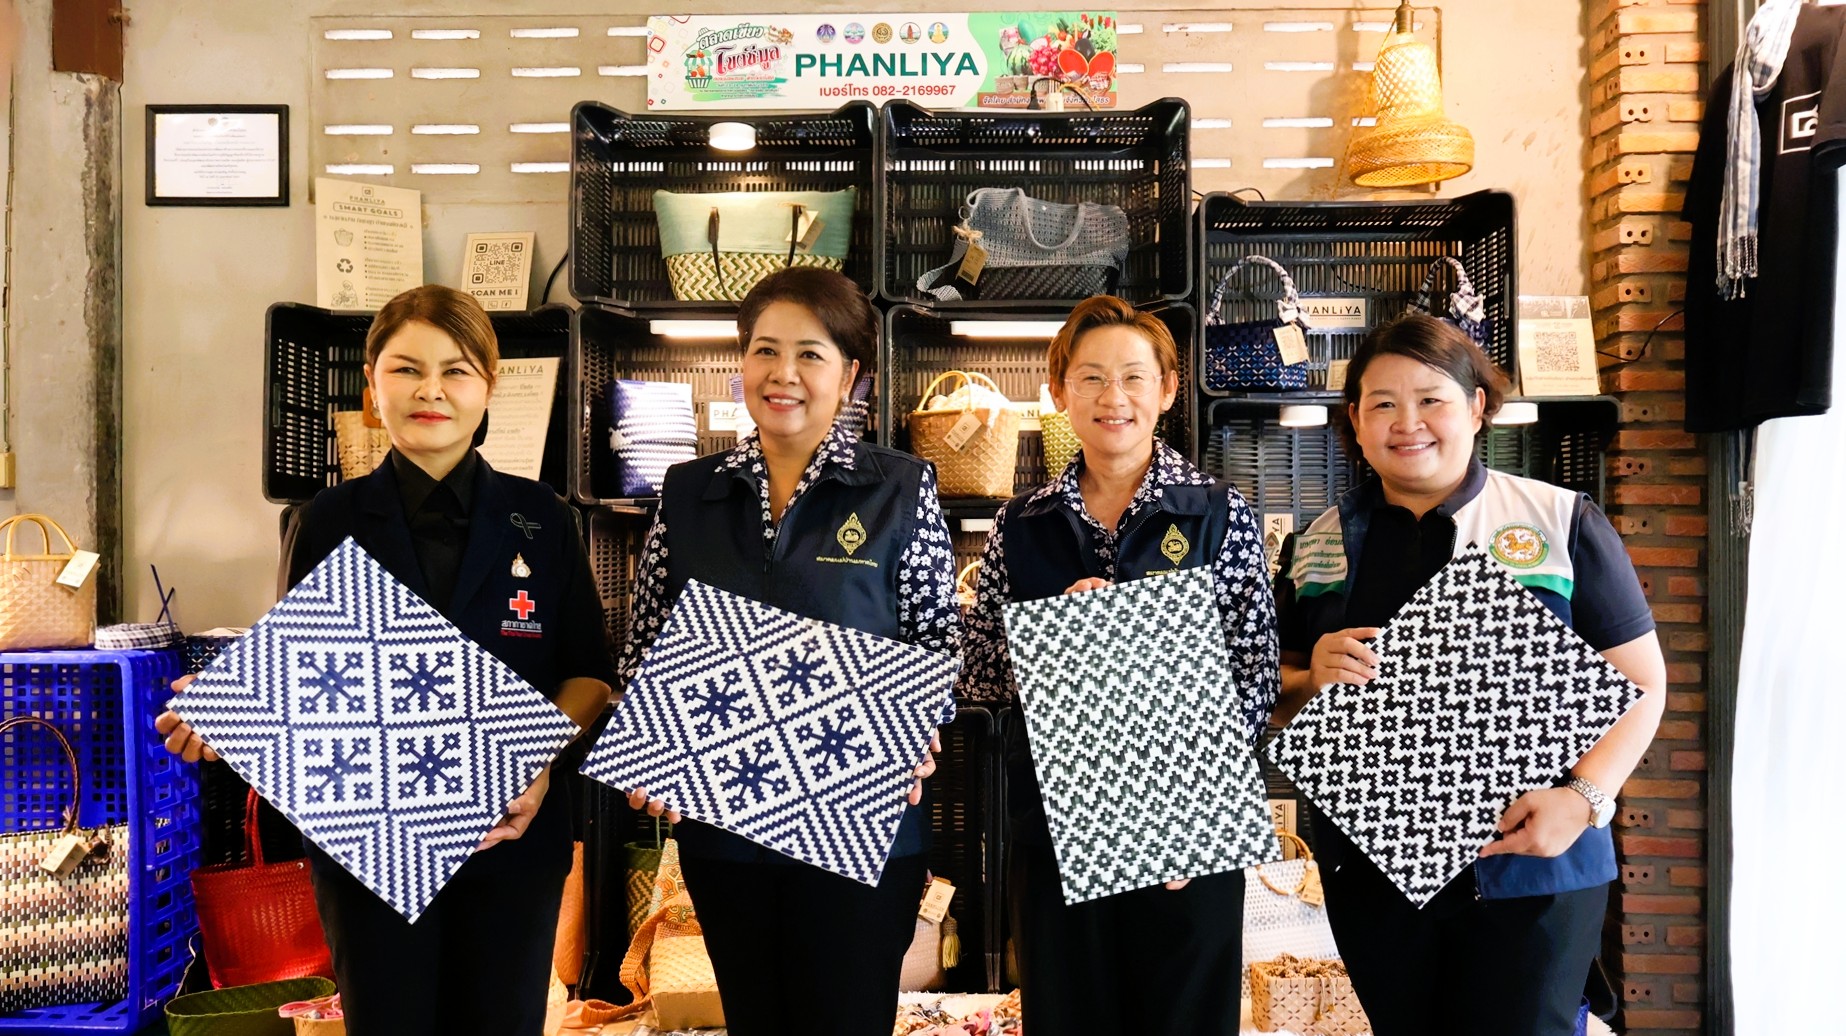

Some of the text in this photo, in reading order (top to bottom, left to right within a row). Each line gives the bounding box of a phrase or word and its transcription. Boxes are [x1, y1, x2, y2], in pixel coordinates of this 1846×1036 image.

[699, 23, 764, 50] ตลาดเขียว
[795, 52, 980, 77] PHANLIYA
[819, 83, 956, 96] เบอร์โทร 082-2169967
[339, 204, 398, 217] SMART GOALS
[471, 289, 496, 297] SCAN
